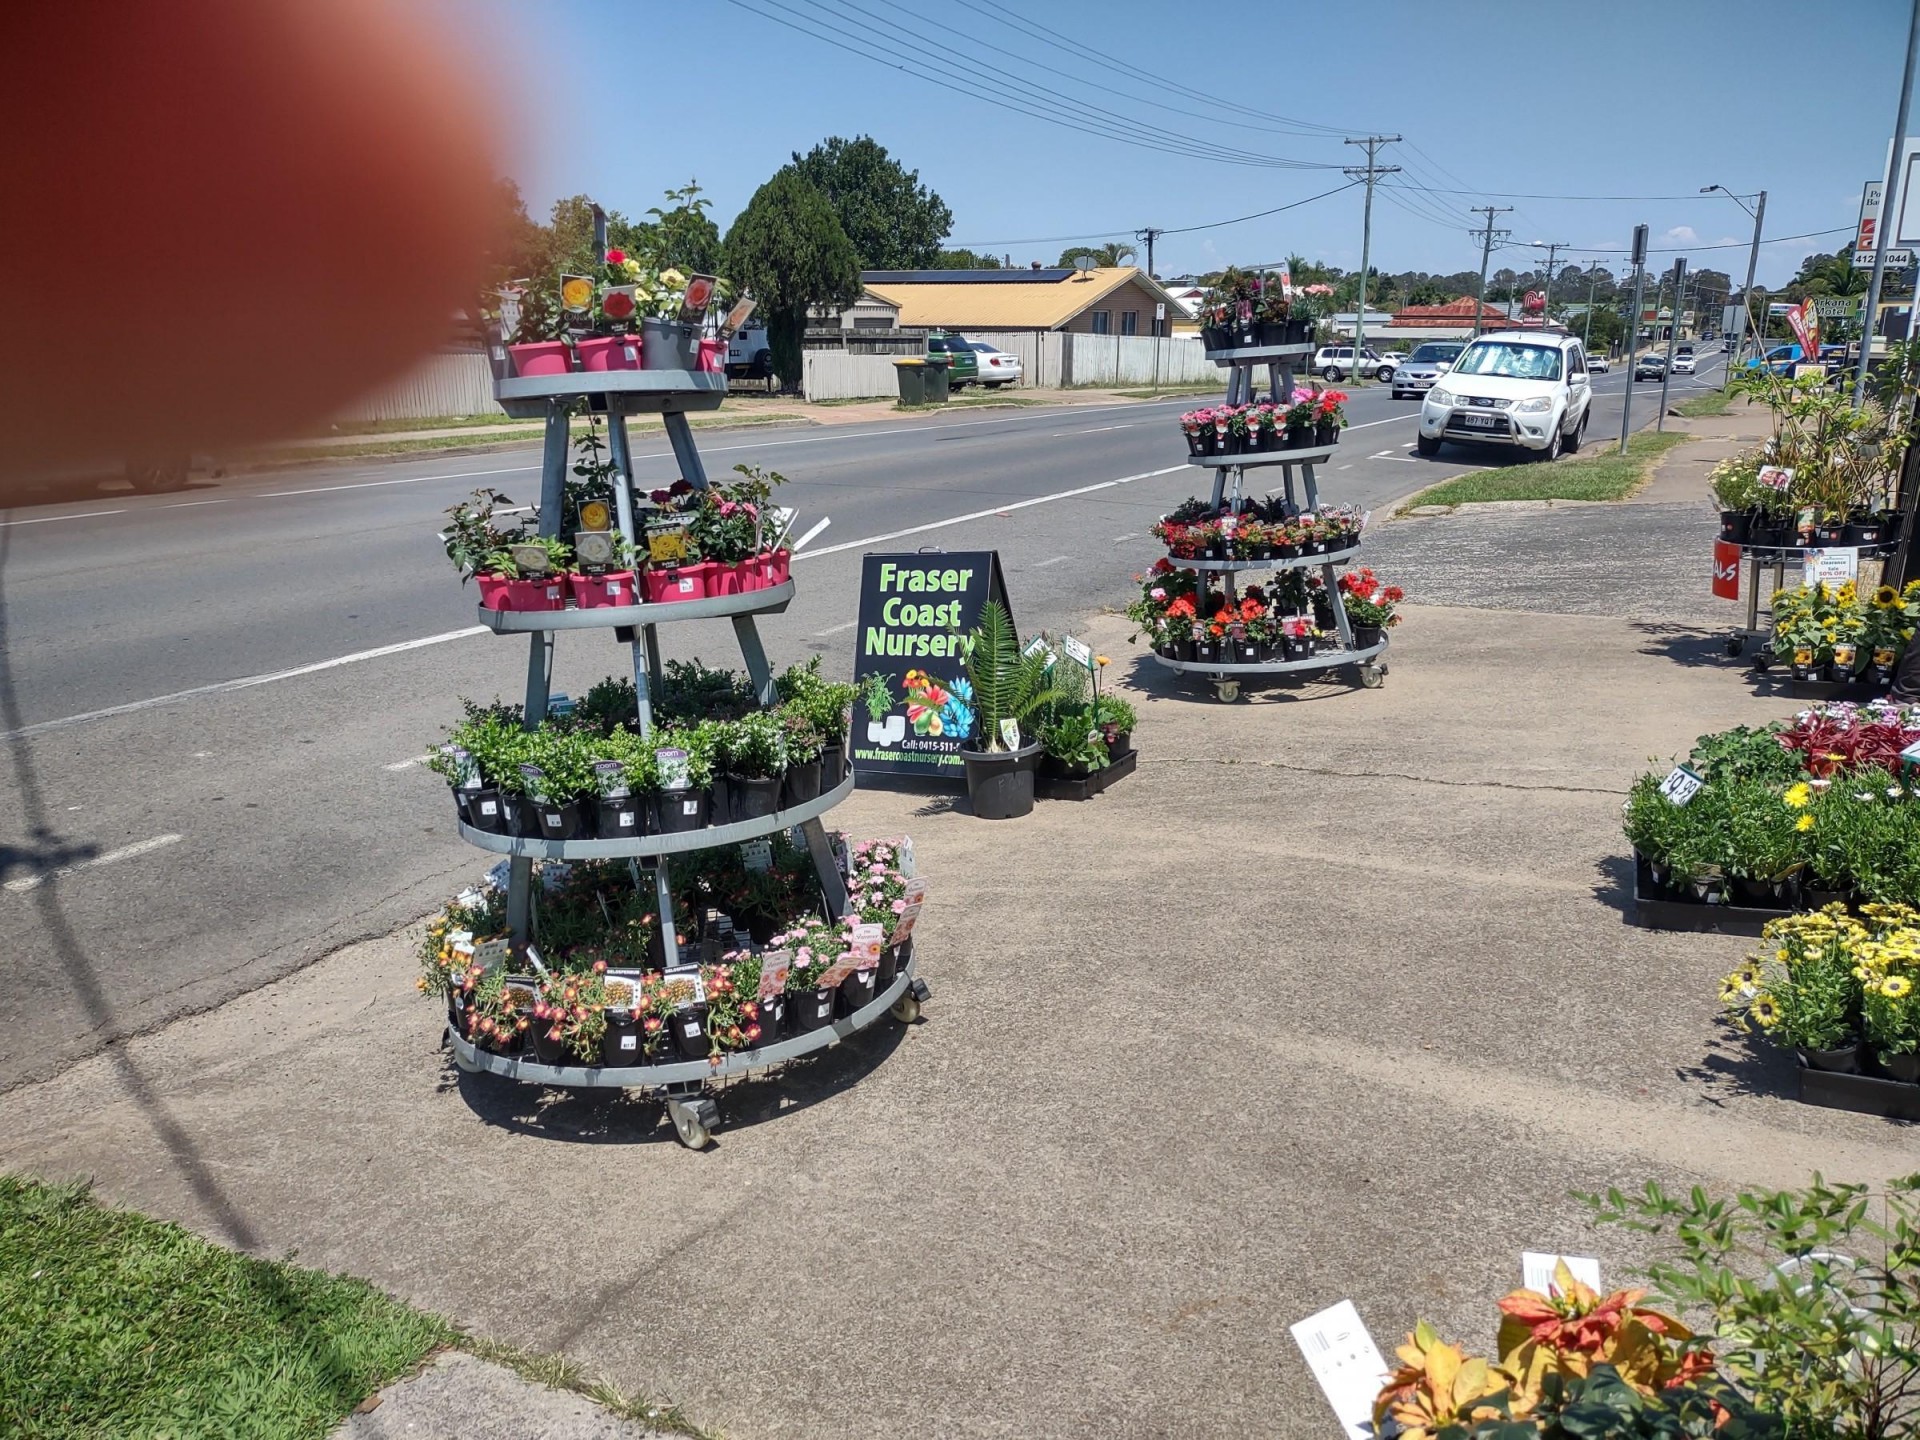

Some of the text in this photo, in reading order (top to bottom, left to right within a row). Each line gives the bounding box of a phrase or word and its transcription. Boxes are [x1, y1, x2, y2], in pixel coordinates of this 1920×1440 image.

[1855, 255, 1876, 263] 412
[1814, 298, 1852, 307] Arkana
[1816, 306, 1847, 316] Motel
[880, 563, 973, 592] Fraser
[883, 597, 962, 627] Coast
[865, 626, 976, 666] Nursery
[902, 739, 918, 749] Call:
[657, 750, 679, 758] zoom
[596, 762, 617, 770] zoom
